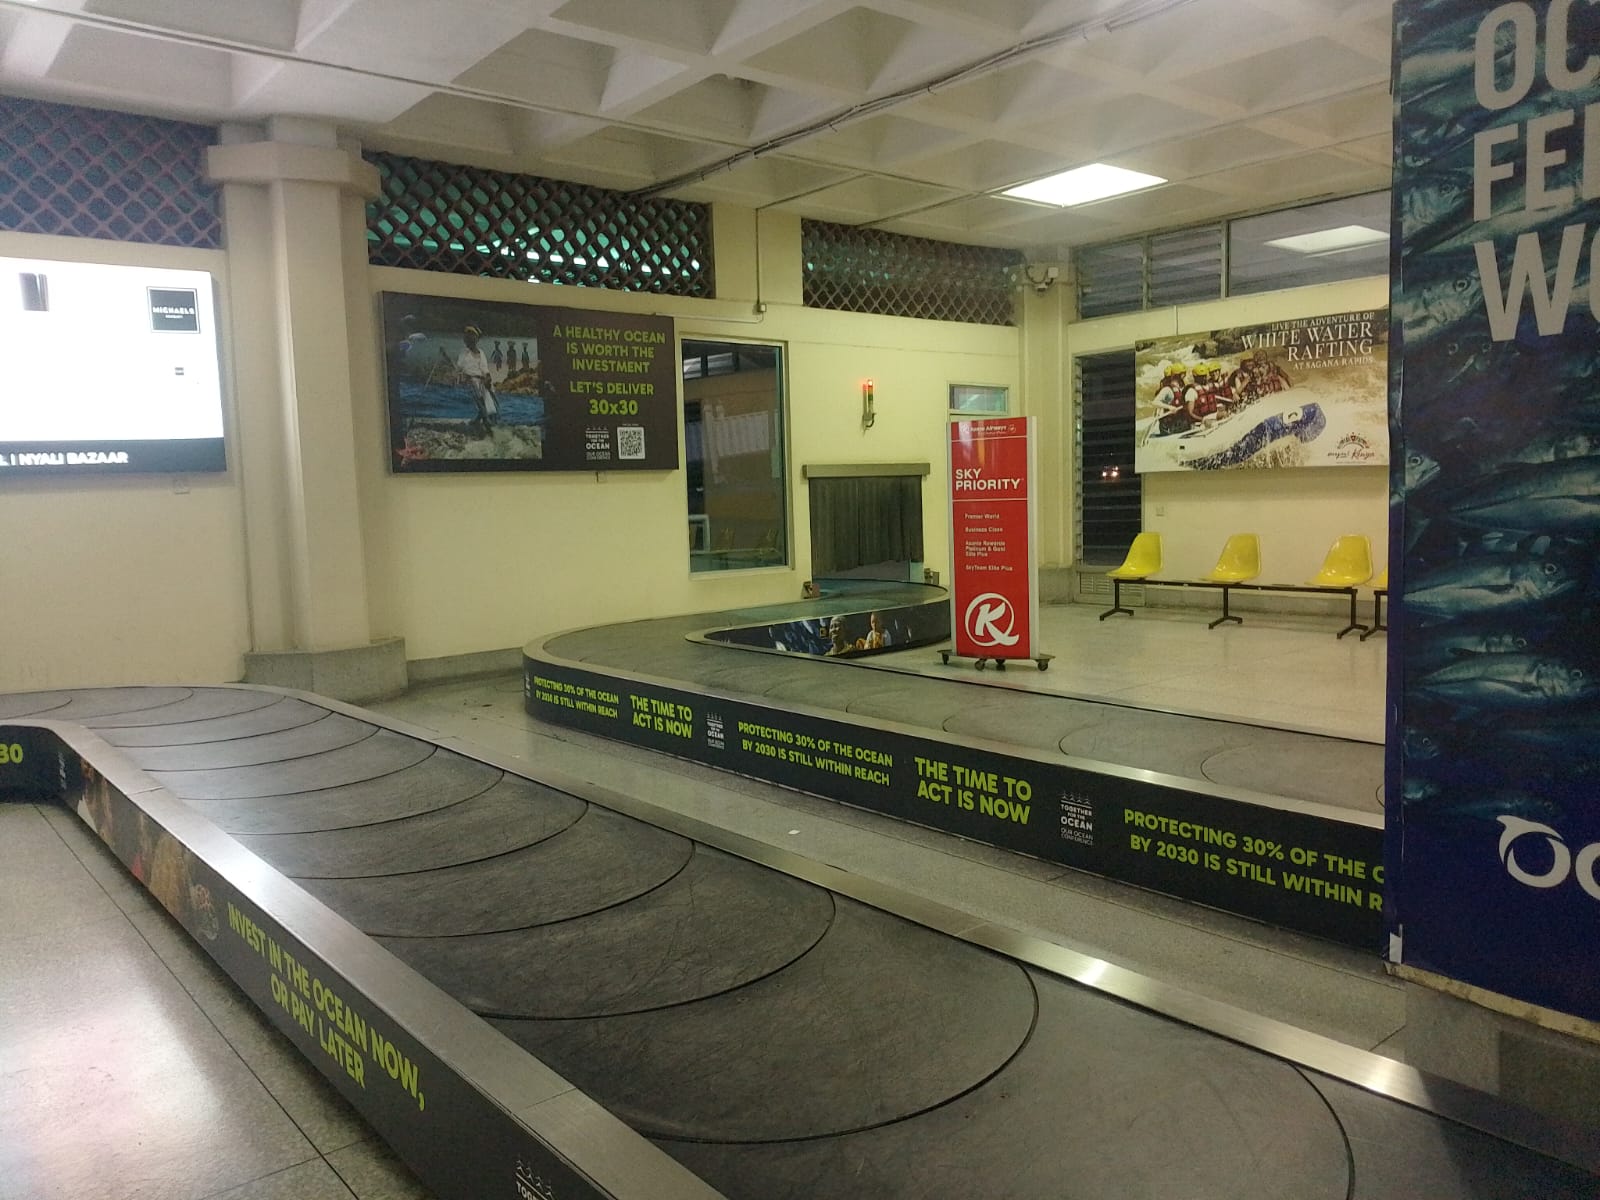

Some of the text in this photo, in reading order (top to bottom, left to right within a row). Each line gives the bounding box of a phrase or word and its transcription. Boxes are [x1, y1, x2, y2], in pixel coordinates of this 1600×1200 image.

[1474, 223, 1600, 342] W
[1271, 312, 1375, 331] LIVE THE ADVENTURE OF
[553, 324, 666, 344] A HEALTHY OCEAN
[1241, 322, 1373, 351] WHITE WATER
[566, 342, 656, 359] IS WORTH THE
[1288, 339, 1373, 362] RAFTING
[572, 358, 651, 374] INVESTMENT
[570, 381, 655, 396] LET'S DELIVER
[589, 399, 639, 415] 30x30
[66, 451, 129, 465] BAZAAR
[955, 468, 982, 480] SKY
[955, 478, 1021, 491] PRIORITY
[553, 695, 560, 705] IS
[560, 696, 575, 709] STILL
[575, 700, 597, 713] WITHIN
[597, 705, 618, 719] REACH
[576, 686, 584, 697] OF
[584, 688, 597, 700] THE
[597, 691, 619, 705] OCEAN
[630, 694, 693, 722] THE TIME TO
[632, 711, 652, 729] ACT
[654, 716, 664, 732] IS
[665, 719, 693, 739] NOW
[738, 721, 793, 744] PROTECTING
[795, 734, 816, 749] 30%
[817, 739, 831, 753] OF
[833, 742, 853, 758] THE
[855, 747, 893, 768] OCEAN
[742, 739, 753, 751] BY
[755, 742, 776, 758] 2030
[777, 747, 787, 760] IS
[789, 751, 813, 767] STILL
[815, 756, 851, 777] WITHIN
[854, 766, 890, 786] REACH
[914, 756, 1032, 801] THE TIME TO
[917, 780, 1031, 825] ACT IS NOW
[1060, 804, 1092, 817] TOGETHER
[1060, 816, 1093, 832] OCEAN
[1124, 808, 1237, 849] PROTECTING
[1242, 835, 1285, 861] 30%
[1290, 847, 1318, 868] OF
[1323, 853, 1366, 881] THE
[1130, 834, 1152, 853] BY
[1156, 840, 1199, 866] 2030
[1204, 852, 1221, 872] IS
[1226, 858, 1277, 886] STILL
[1282, 870, 1363, 908] WITHIN
[227, 902, 426, 1112] INVEST IN THE OCEAN NOW,
[270, 973, 365, 1089] OR PAY LATER
